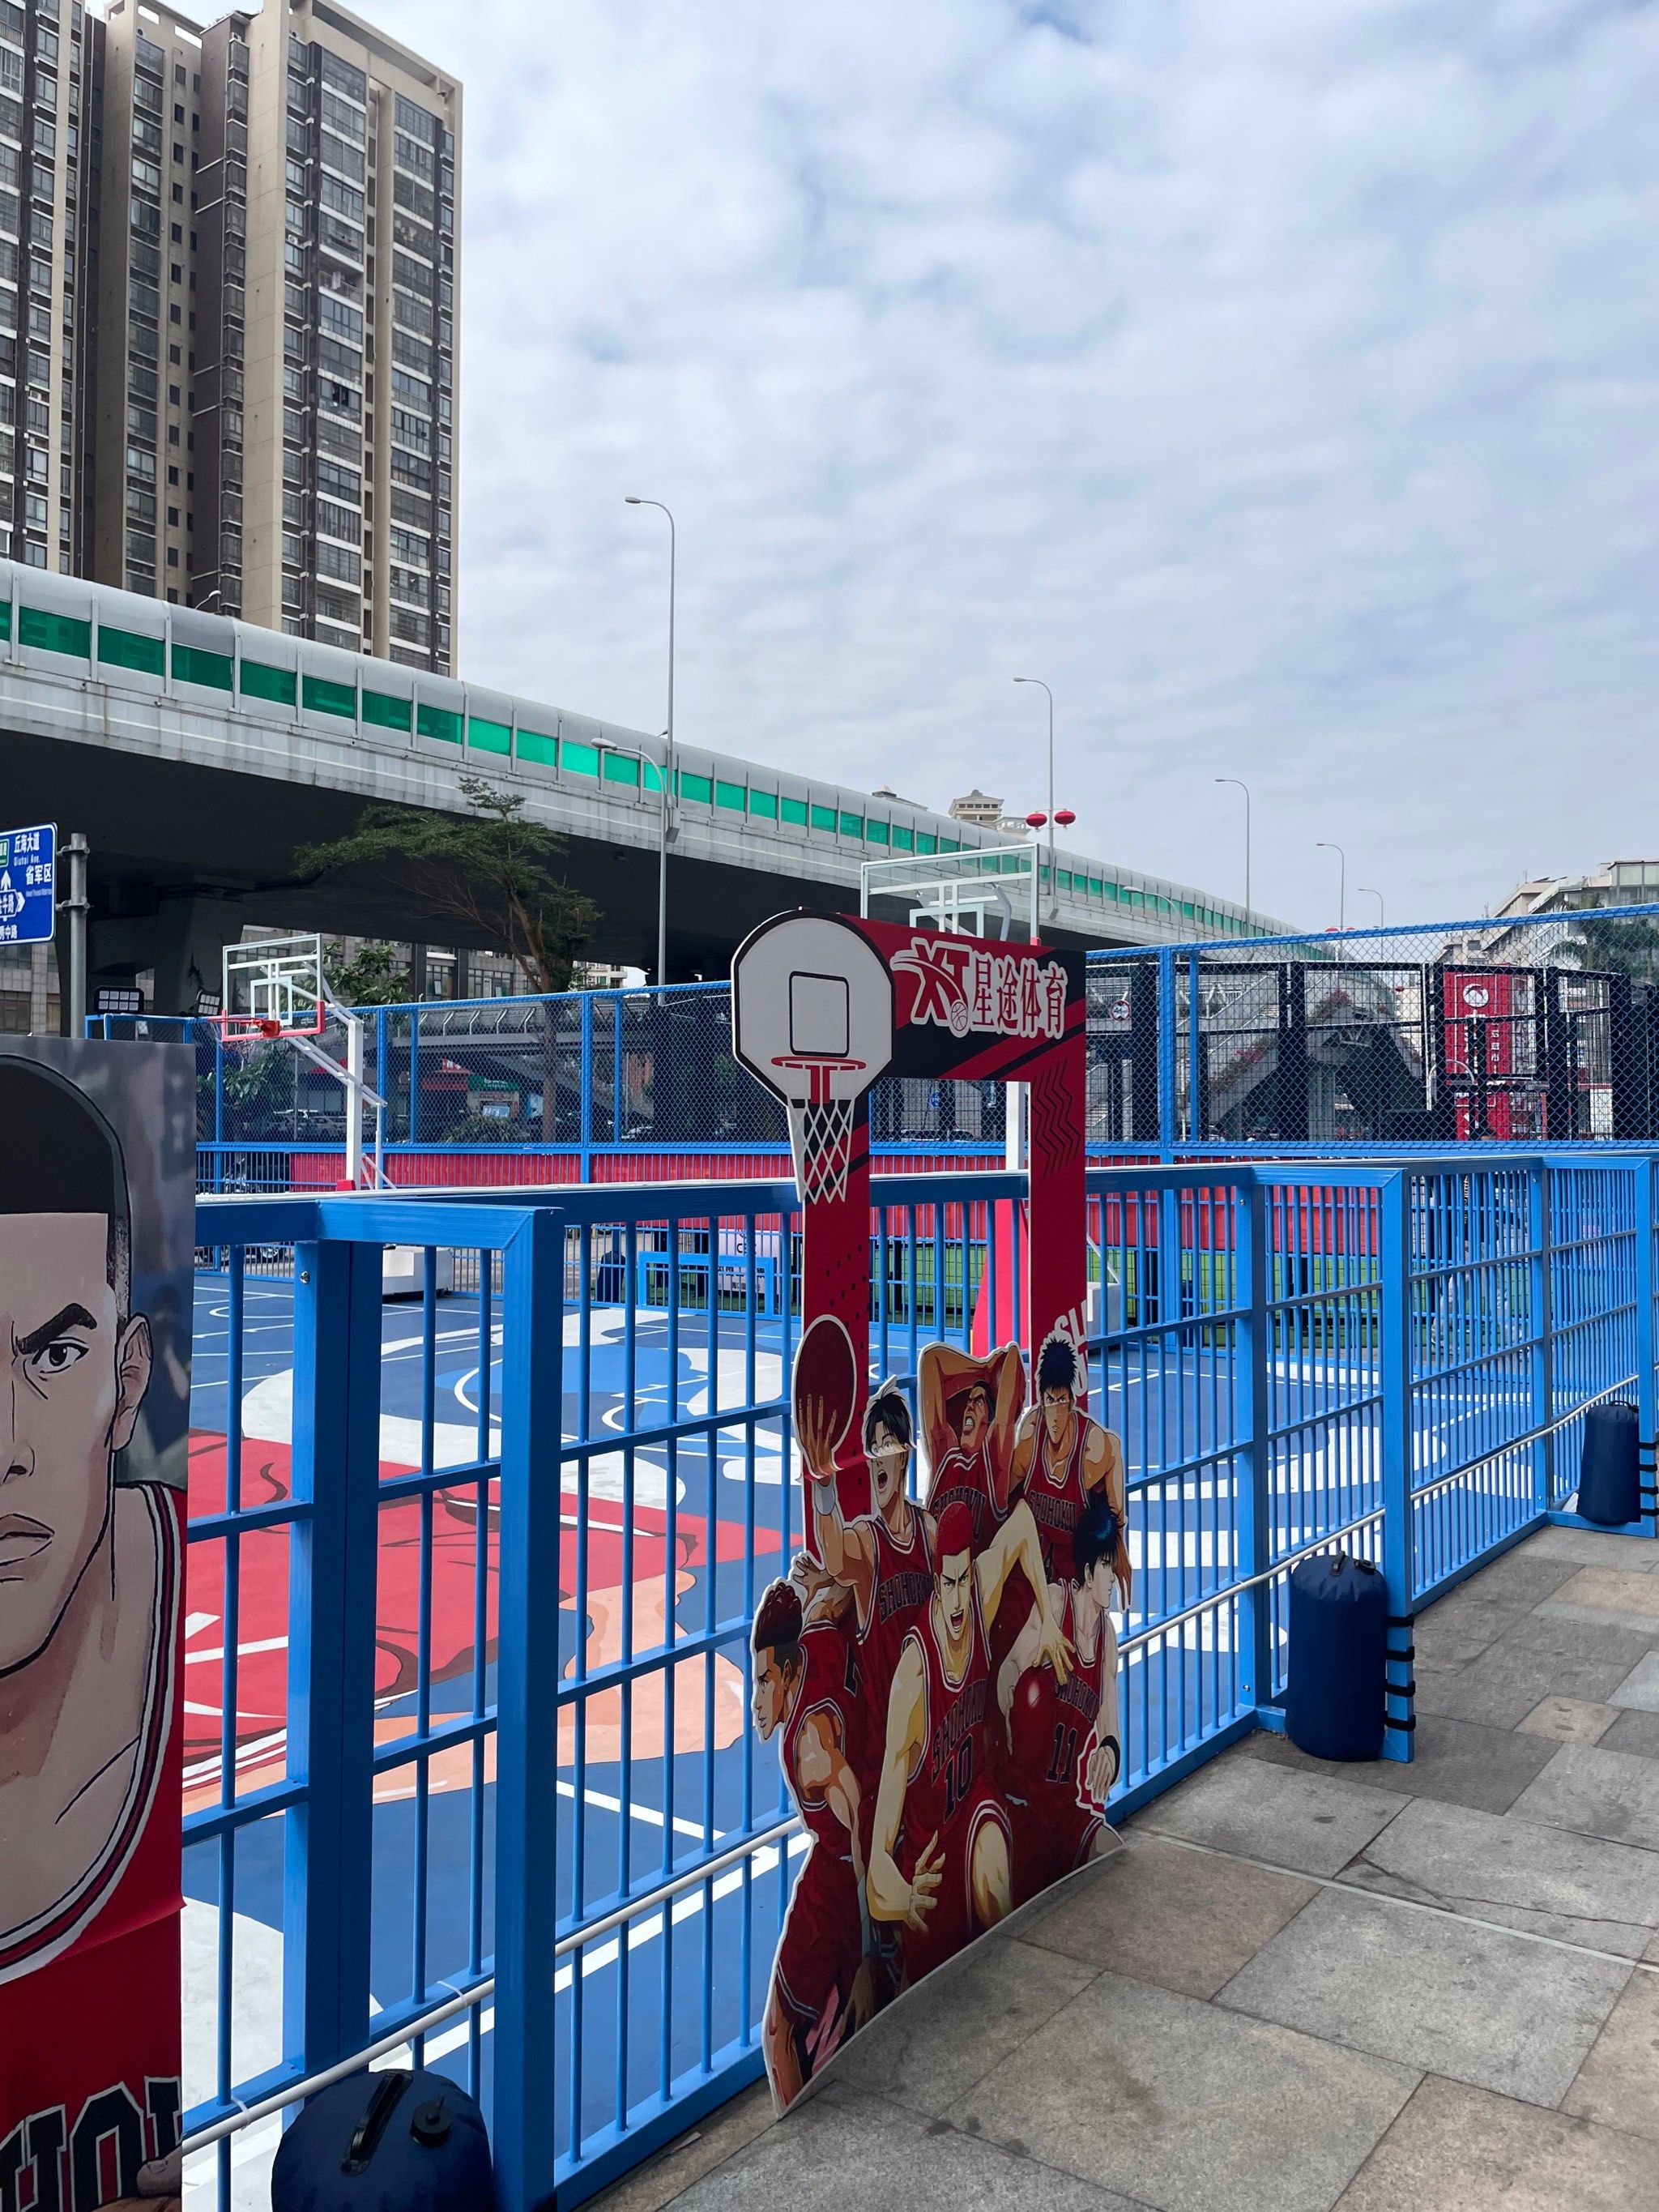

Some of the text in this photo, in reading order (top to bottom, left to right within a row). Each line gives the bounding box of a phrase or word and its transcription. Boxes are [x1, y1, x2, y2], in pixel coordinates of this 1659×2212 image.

[25, 863, 52, 886] 省军区
[973, 950, 1068, 1040] 星途体育
[944, 1732, 973, 1825] 10
[1046, 1722, 1078, 1784] 11
